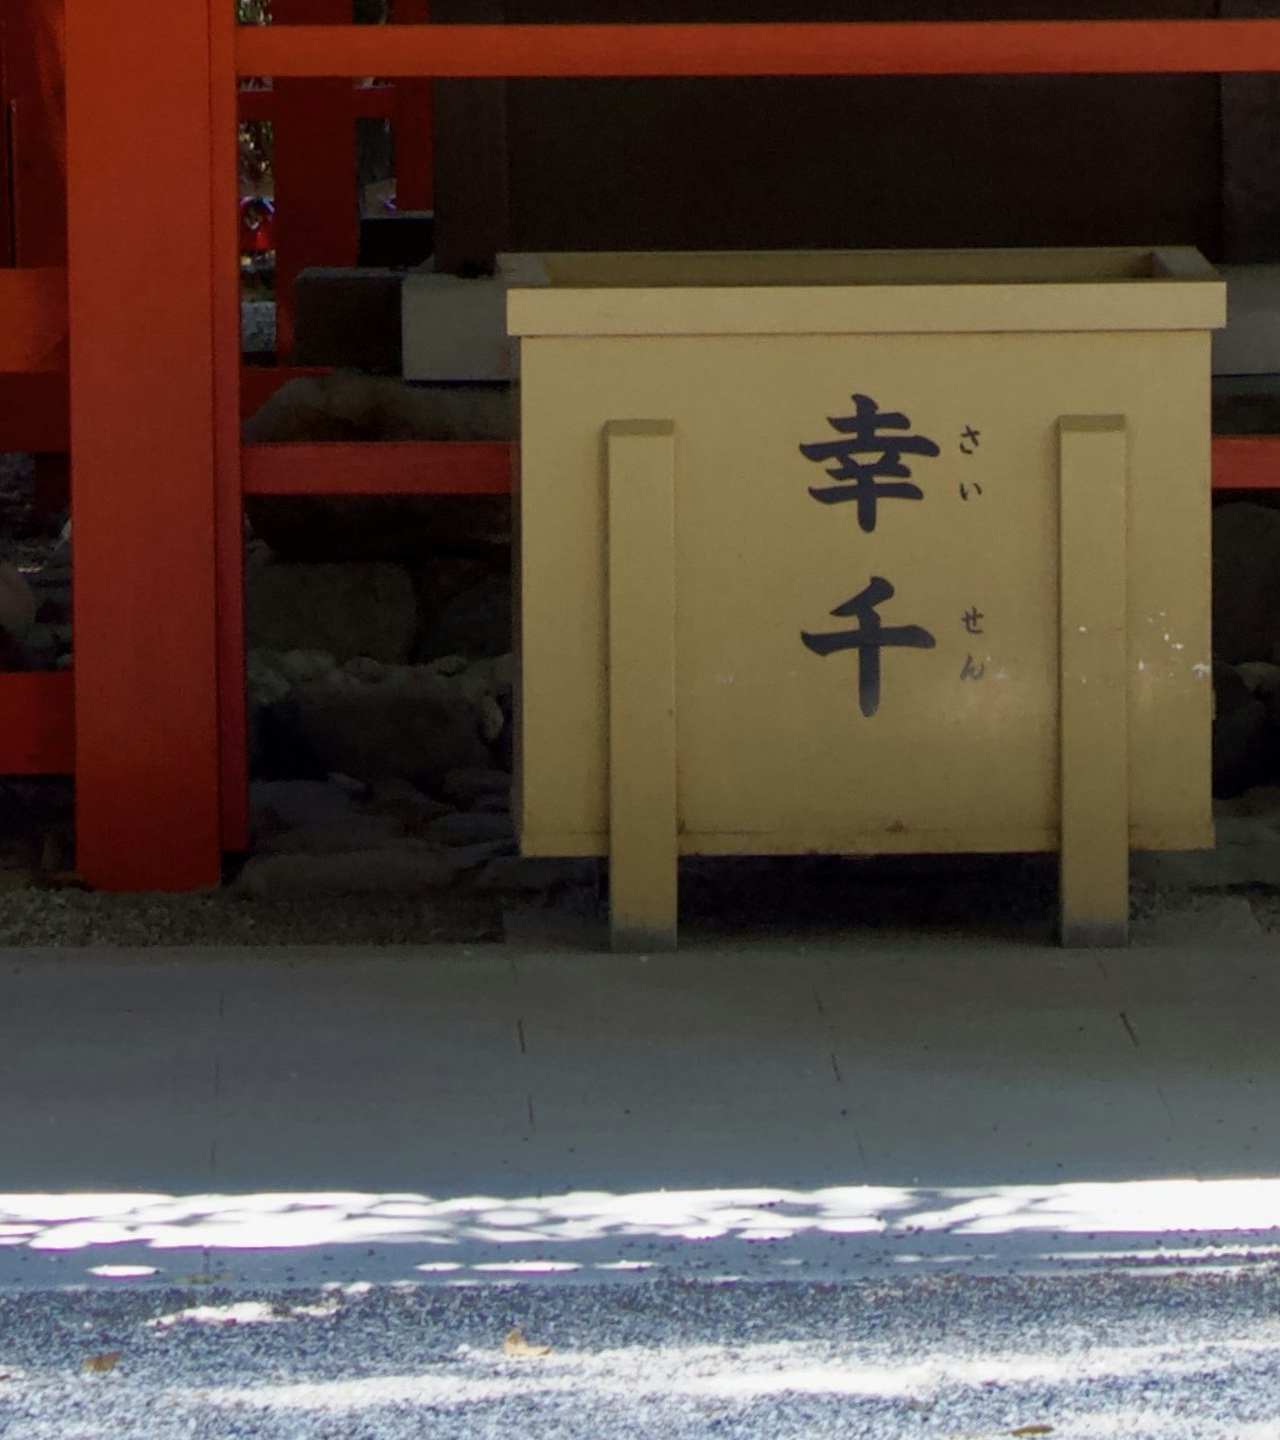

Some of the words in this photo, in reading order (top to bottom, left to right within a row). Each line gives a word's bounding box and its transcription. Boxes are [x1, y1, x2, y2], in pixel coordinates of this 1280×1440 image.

[799, 393, 942, 718] 幸千
[957, 424, 986, 683] さいせん
